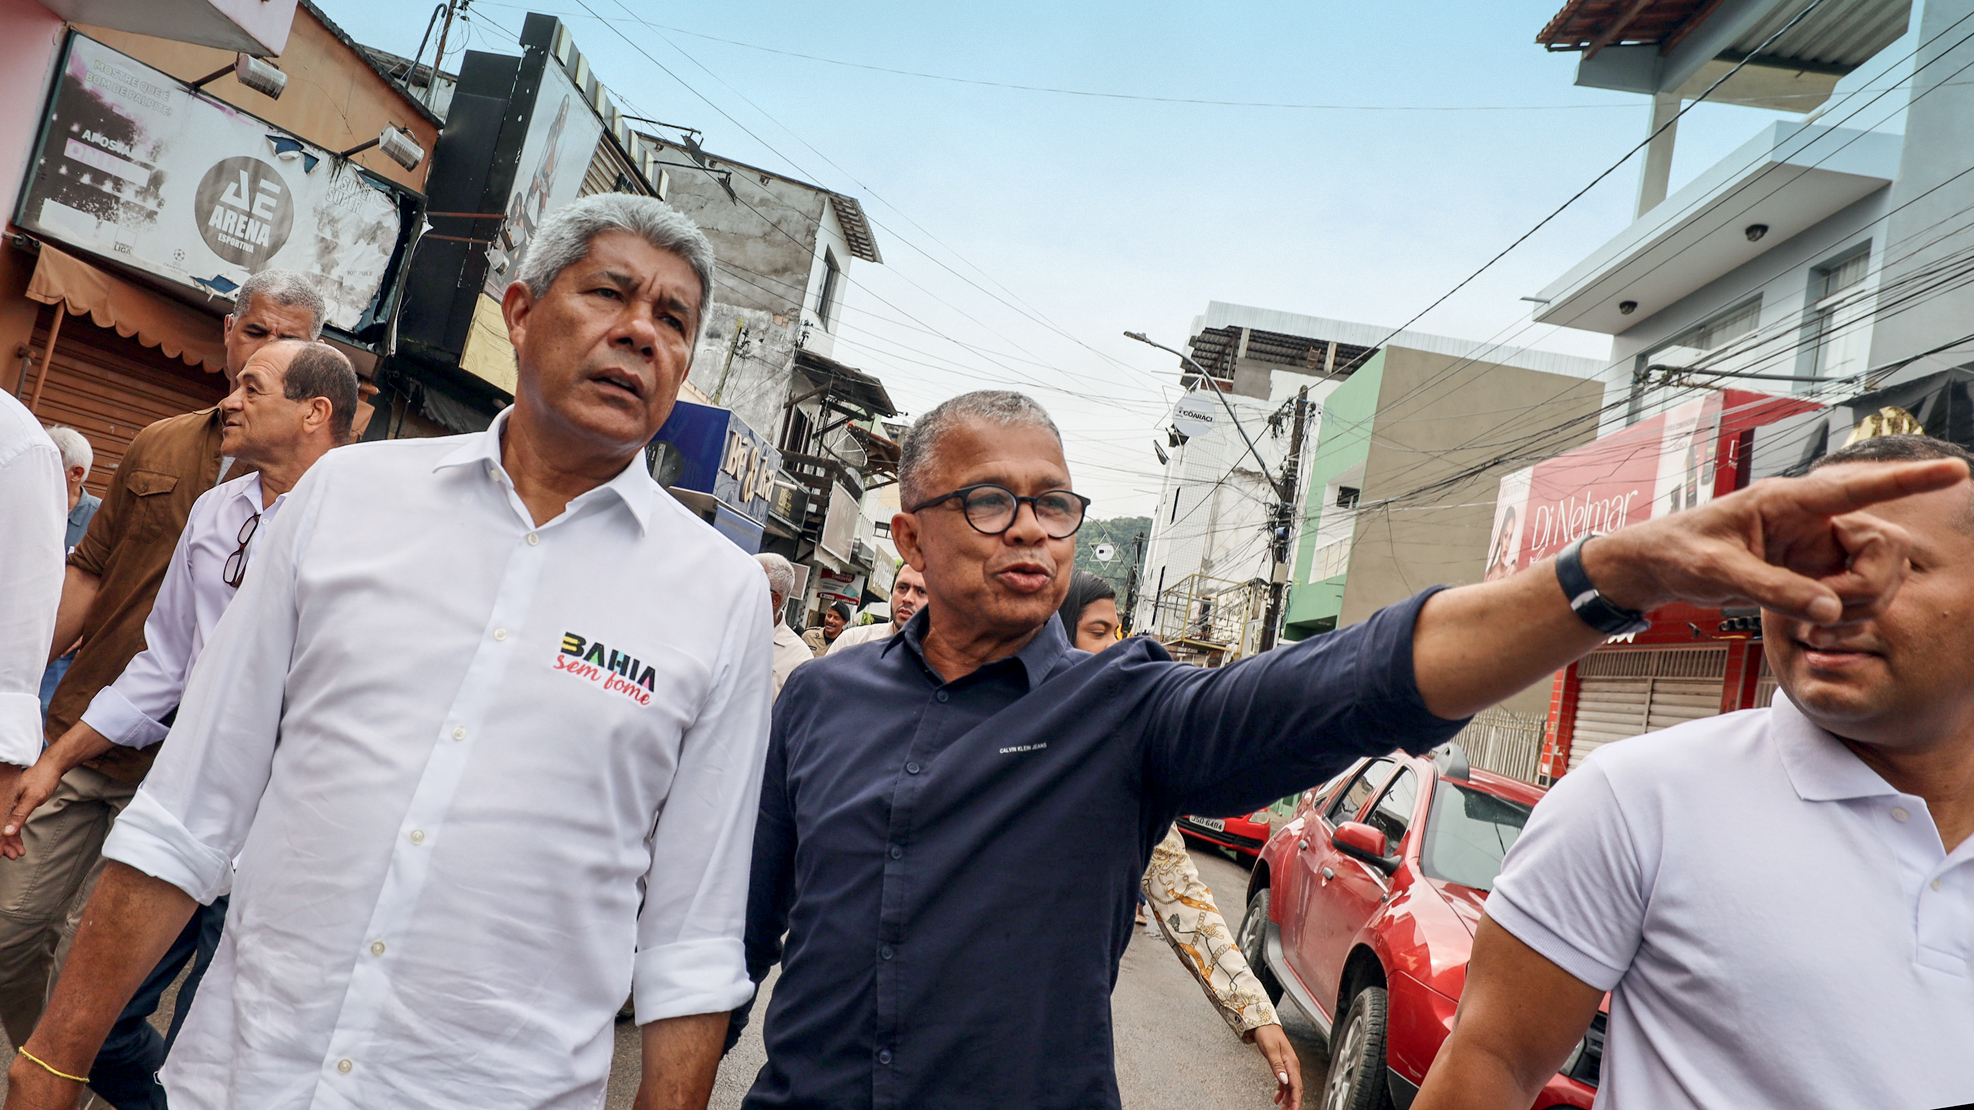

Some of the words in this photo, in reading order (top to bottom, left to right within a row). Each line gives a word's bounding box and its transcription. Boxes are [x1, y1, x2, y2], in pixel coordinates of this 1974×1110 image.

[85, 71, 111, 90] BOM
[111, 84, 127, 98] DE
[127, 91, 173, 117] PALPITE!
[94, 60, 138, 87] MOSTRE
[140, 81, 162, 101] QUE
[326, 187, 362, 215] SUPER
[208, 204, 271, 248] ARENA
[218, 233, 254, 253] ESPORTIVA
[113, 243, 132, 256] LIGA
[1532, 505, 1555, 551] Di
[1553, 490, 1639, 543] Nelmar
[553, 654, 602, 682] sem
[603, 671, 651, 706] fome
[561, 632, 656, 693] BAHIA
[1000, 746, 1017, 754] CALVIN
[1032, 742, 1047, 750] JEANS
